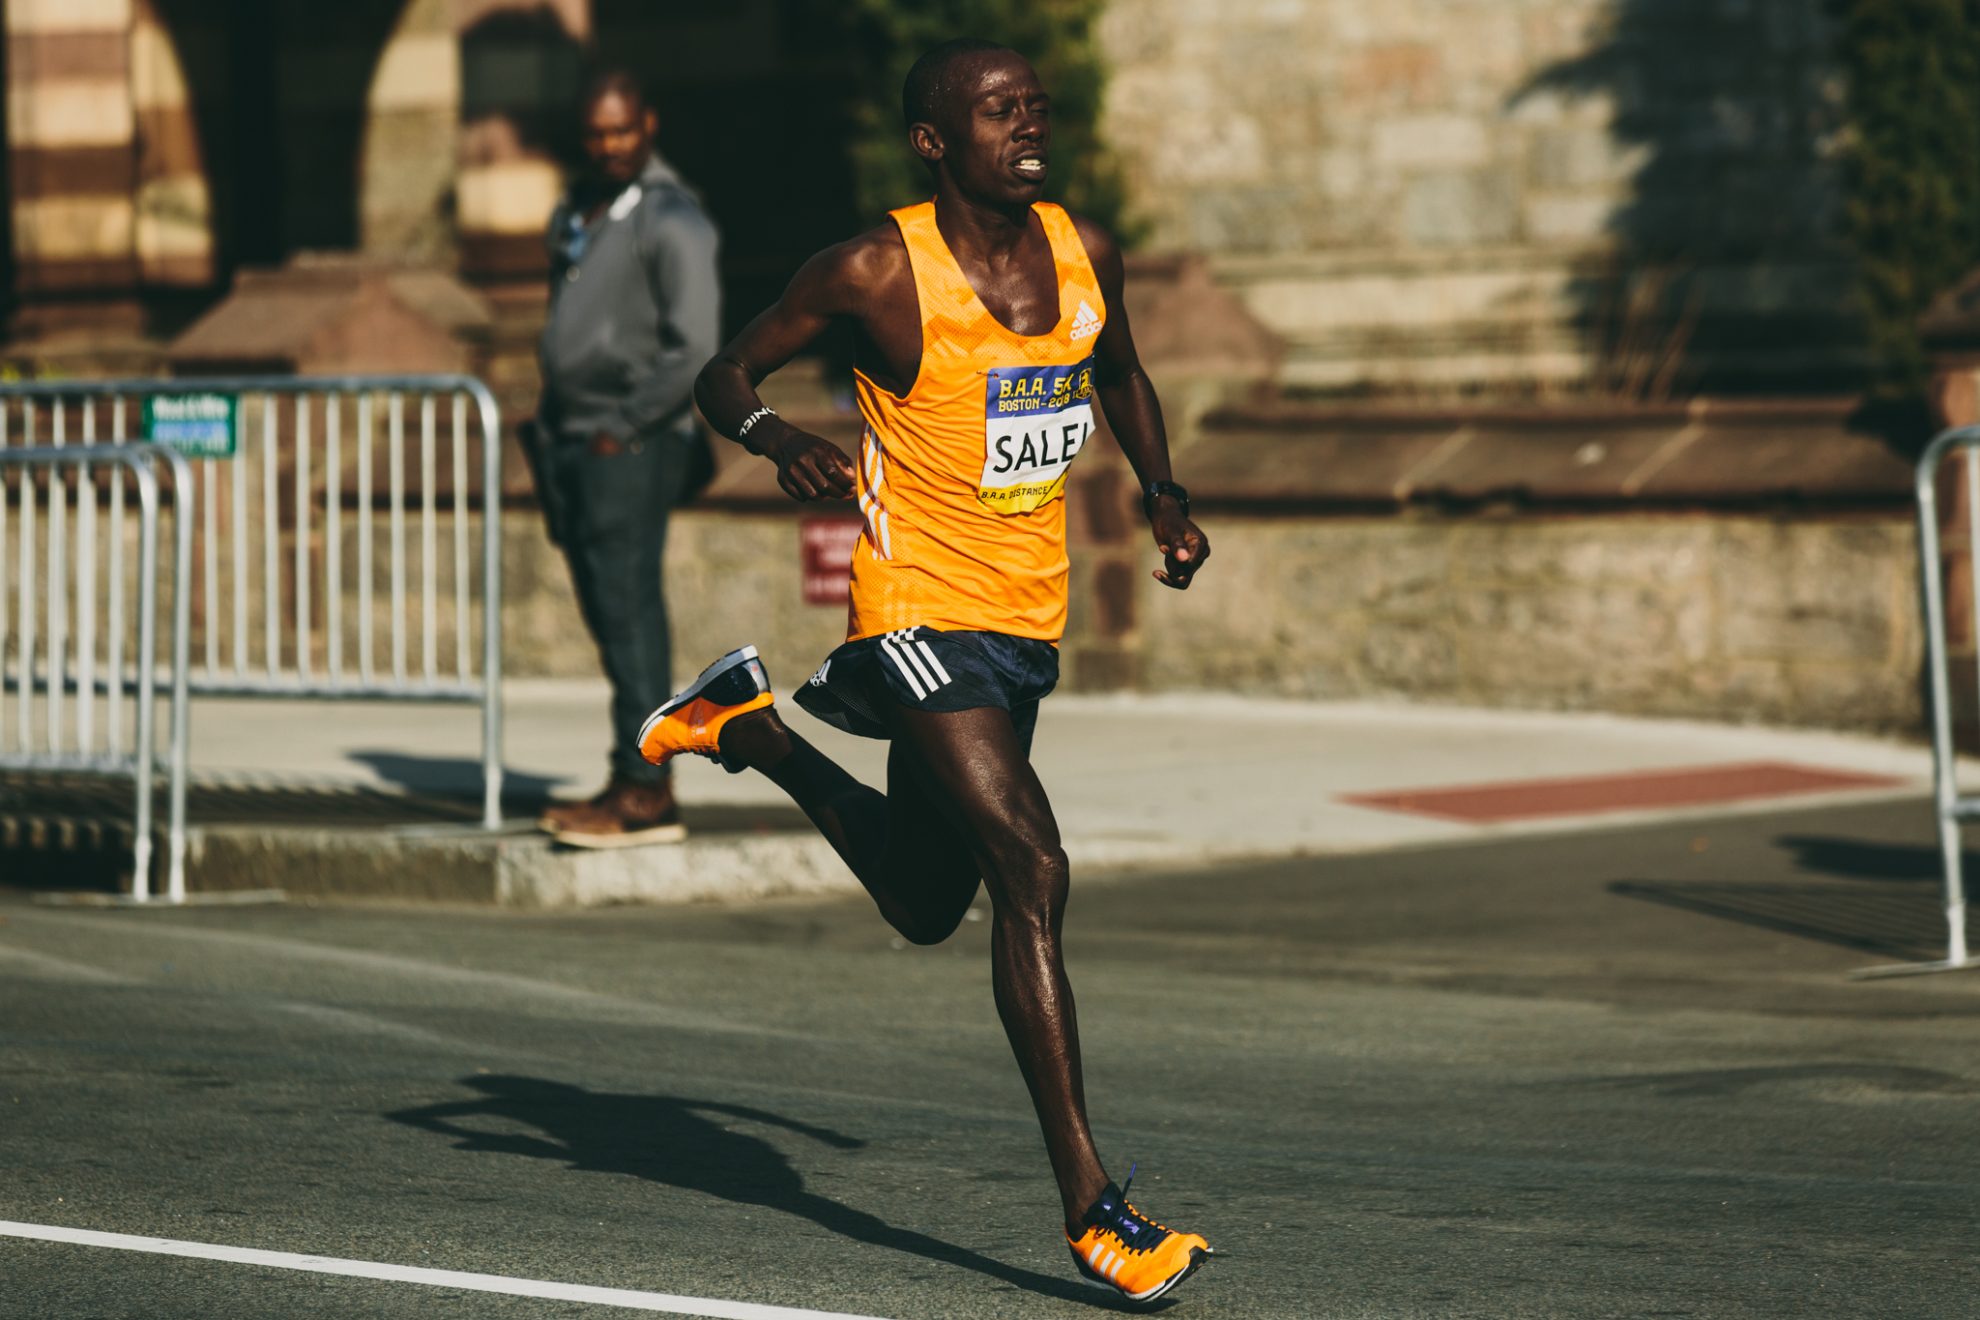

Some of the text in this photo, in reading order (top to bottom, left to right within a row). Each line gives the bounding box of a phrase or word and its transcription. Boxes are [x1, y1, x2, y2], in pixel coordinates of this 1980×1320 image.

[999, 377, 1047, 398] B.A.A.
[1053, 373, 1074, 396] 5K
[998, 398, 1040, 413] BOSTON
[1008, 486, 1049, 499] DISTANCE
